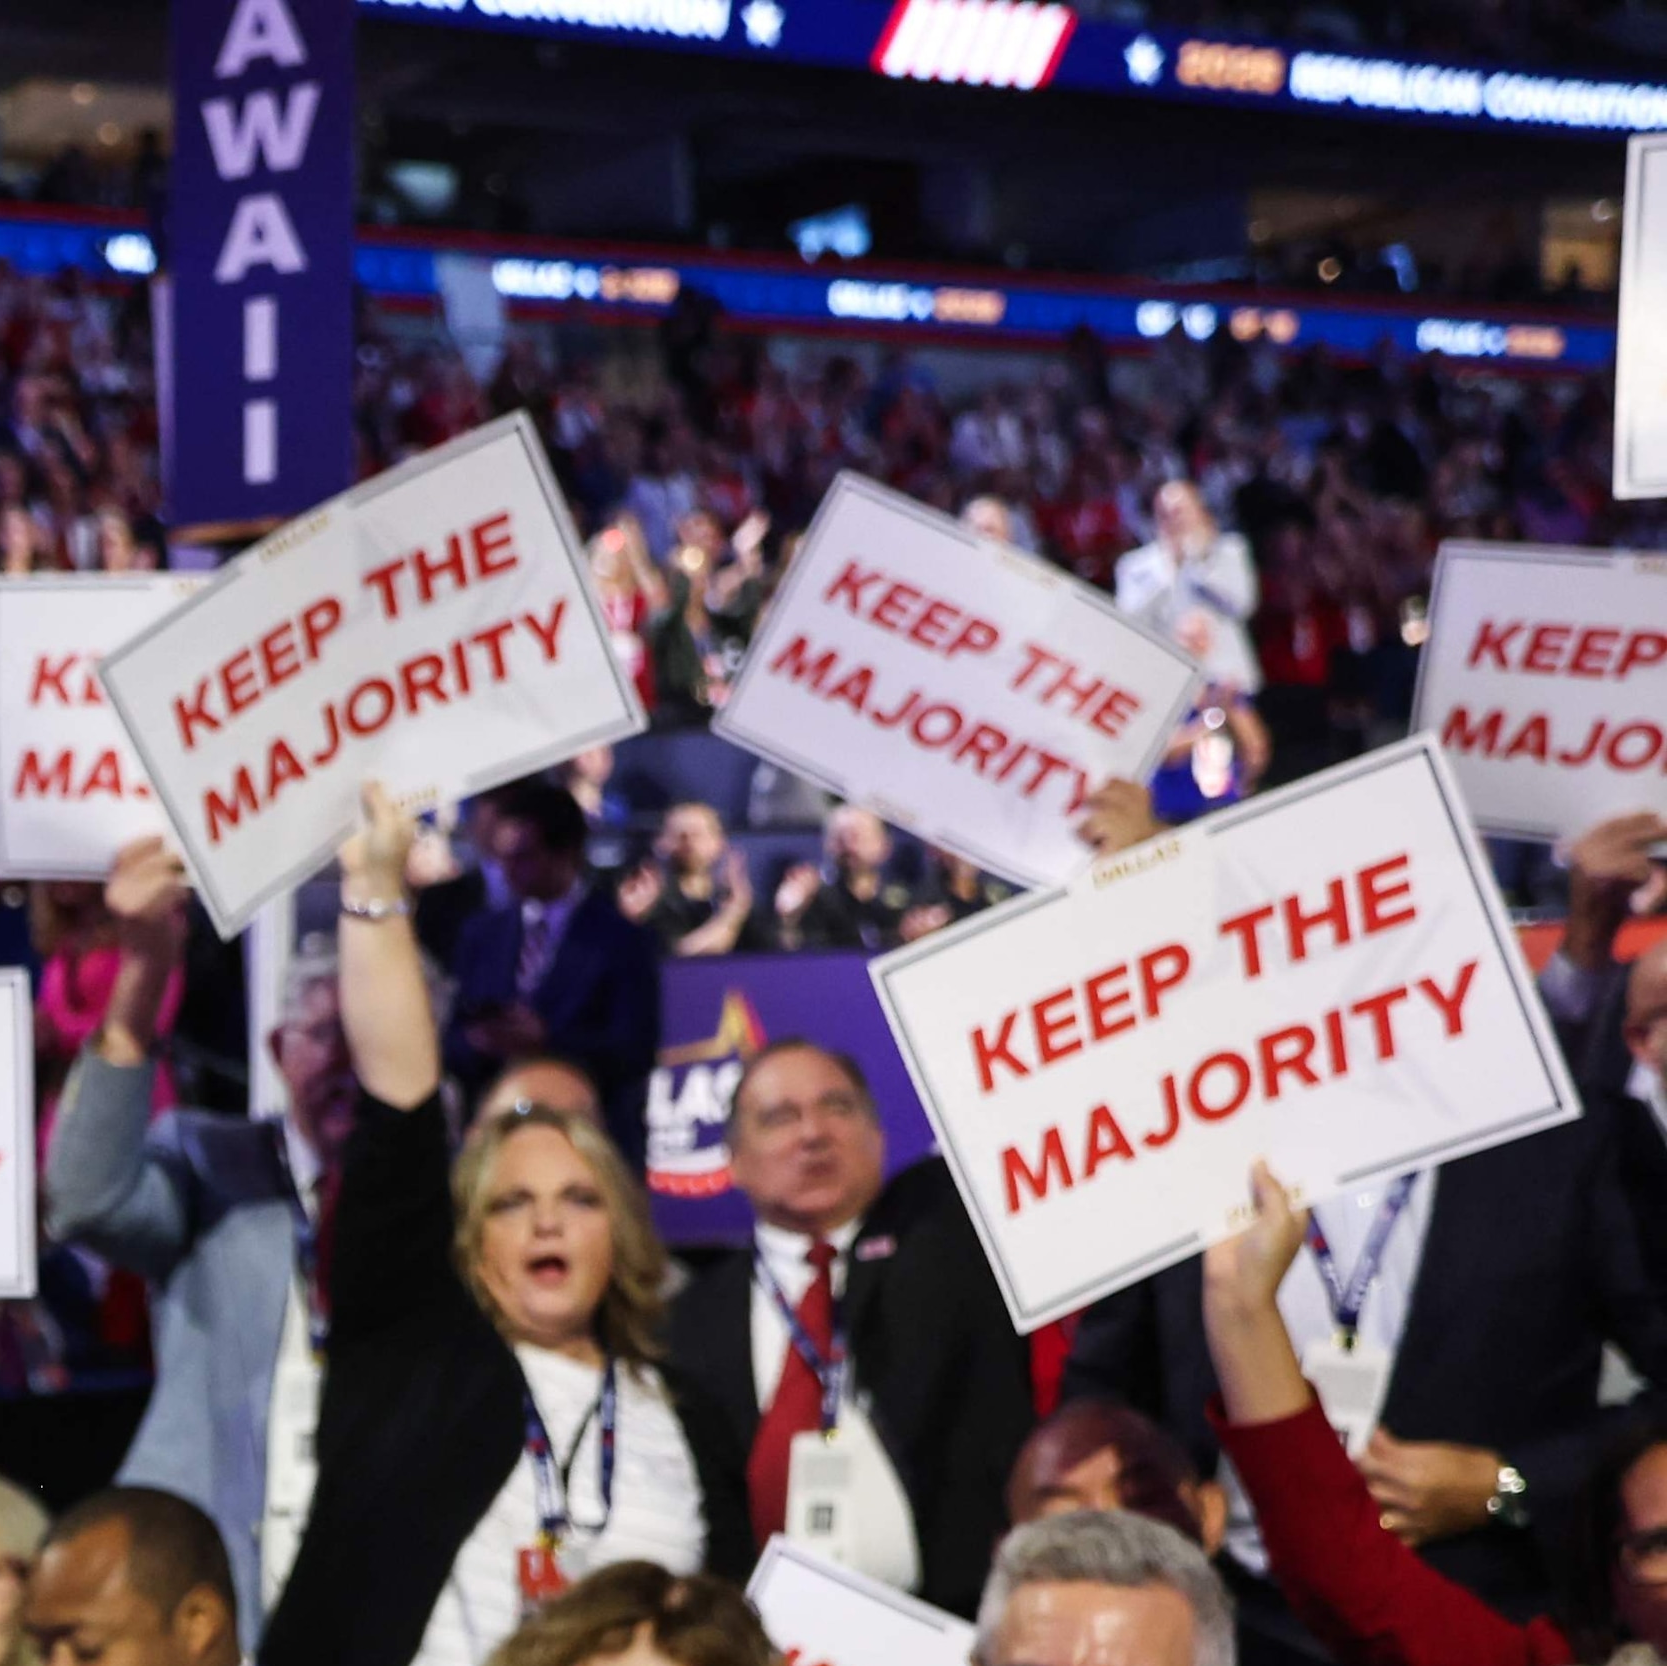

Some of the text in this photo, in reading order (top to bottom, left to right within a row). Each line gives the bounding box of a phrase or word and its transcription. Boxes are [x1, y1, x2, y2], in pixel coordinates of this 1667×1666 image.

[172, 513, 518, 749] KEEP THE
[201, 599, 568, 846] MAJORITY
[769, 635, 1091, 816] MAJORITY
[824, 559, 1002, 659] KEEP
[1011, 639, 1142, 739] THE
[1441, 705, 1667, 775] MAJO
[970, 852, 1419, 1094] KEEP THE
[1000, 960, 1480, 1217] MAJORITY
